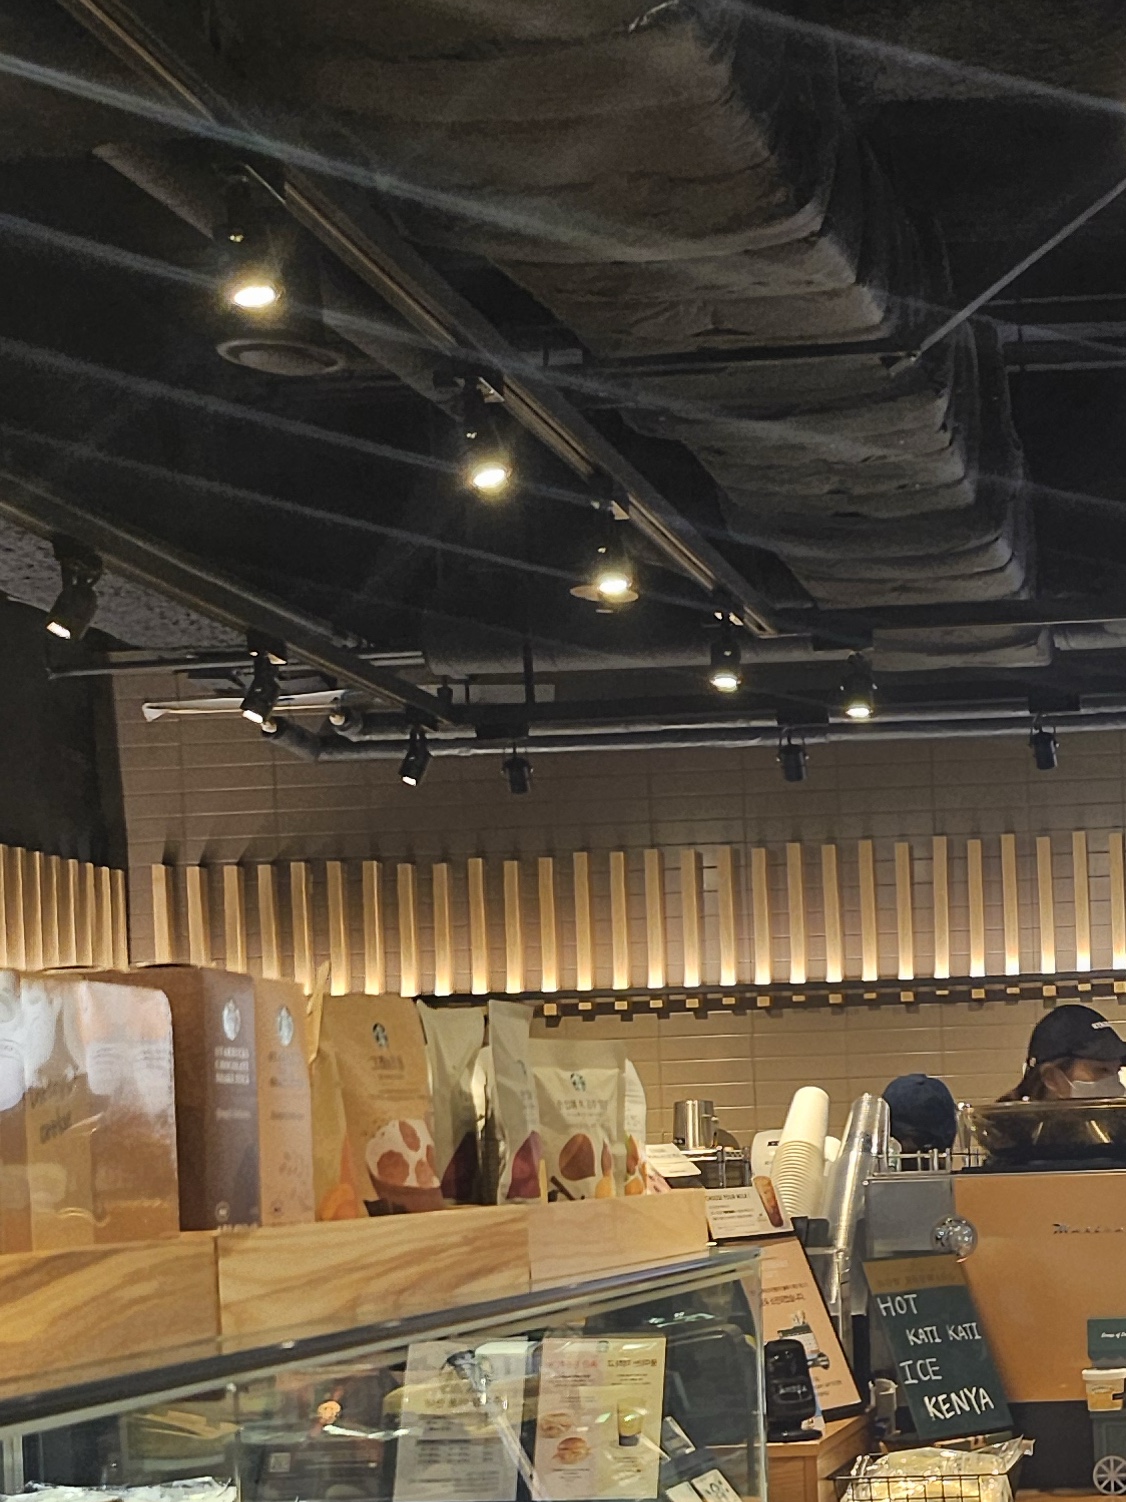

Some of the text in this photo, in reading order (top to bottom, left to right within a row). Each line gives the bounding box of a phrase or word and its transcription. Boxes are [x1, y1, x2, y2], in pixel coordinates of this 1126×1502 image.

[877, 1294, 918, 1317] HOT
[906, 1322, 982, 1346] KATI KATI
[899, 1358, 943, 1385] ICE
[923, 1386, 995, 1421] KENYA
